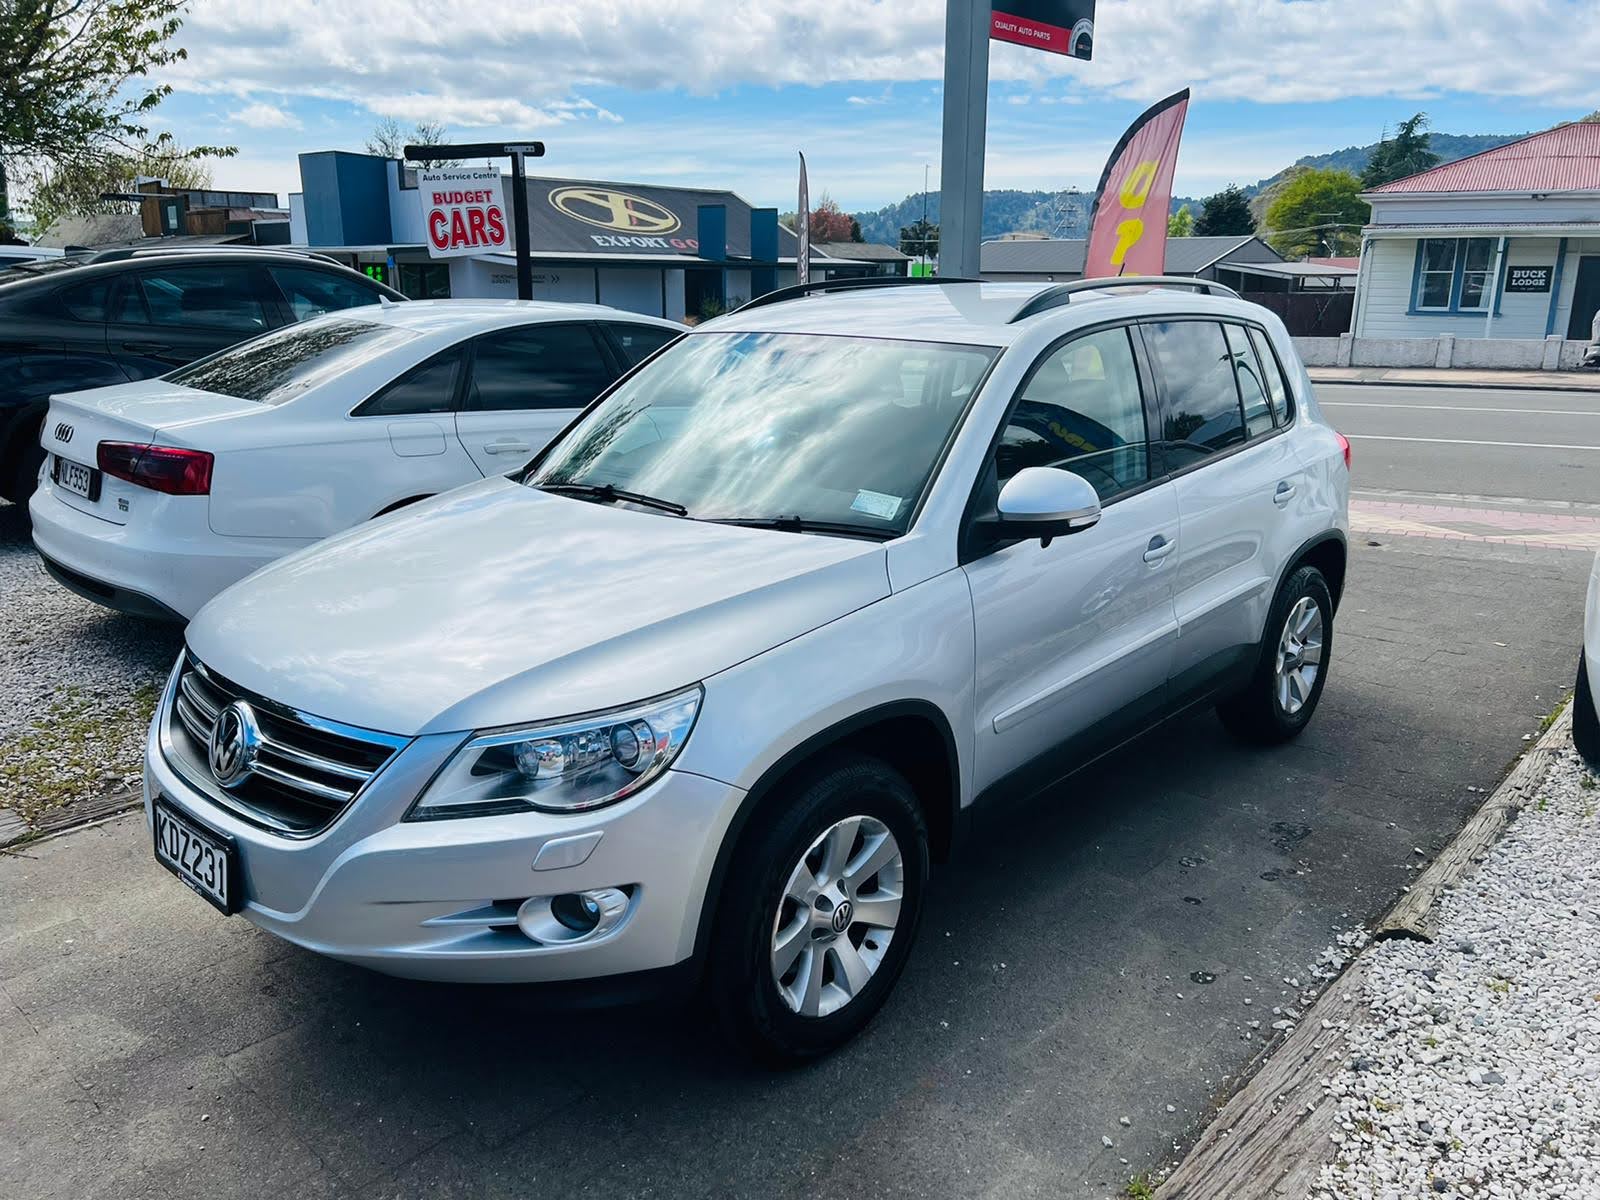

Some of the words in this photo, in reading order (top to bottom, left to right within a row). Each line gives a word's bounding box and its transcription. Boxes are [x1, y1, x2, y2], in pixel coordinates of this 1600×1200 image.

[994, 20, 1017, 32] QUALITY
[1018, 27, 1033, 36] AUTO
[1033, 30, 1051, 41] PARTS
[473, 172, 498, 180] Centre
[432, 190, 492, 205] BUDGET
[428, 205, 505, 251] CARS
[590, 235, 670, 248] EXPORT
[1512, 270, 1547, 278] BUCK
[61, 462, 89, 492] NLF553
[157, 812, 224, 898] KDZ231
